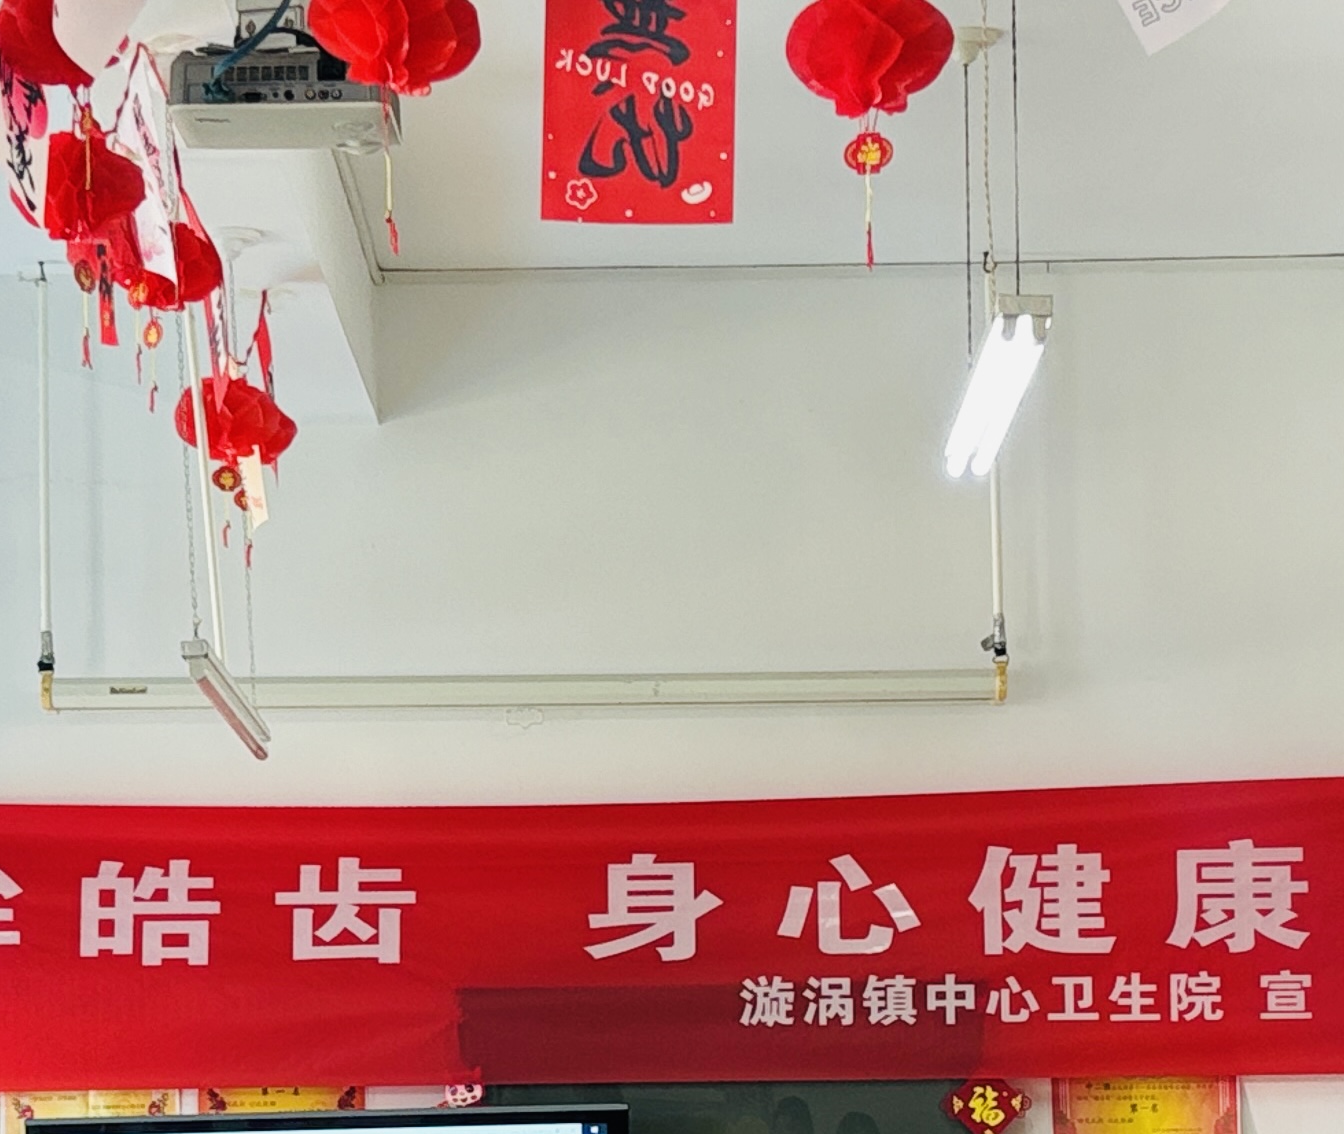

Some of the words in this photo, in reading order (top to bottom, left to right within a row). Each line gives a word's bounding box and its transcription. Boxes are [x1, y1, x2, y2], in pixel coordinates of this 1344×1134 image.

[583, 839, 1311, 961] 身心健康
[739, 974, 1224, 1028] 漩涡镇中心卫生院
[1259, 971, 1314, 1022] 宣
[968, 1086, 1007, 1126] 福
